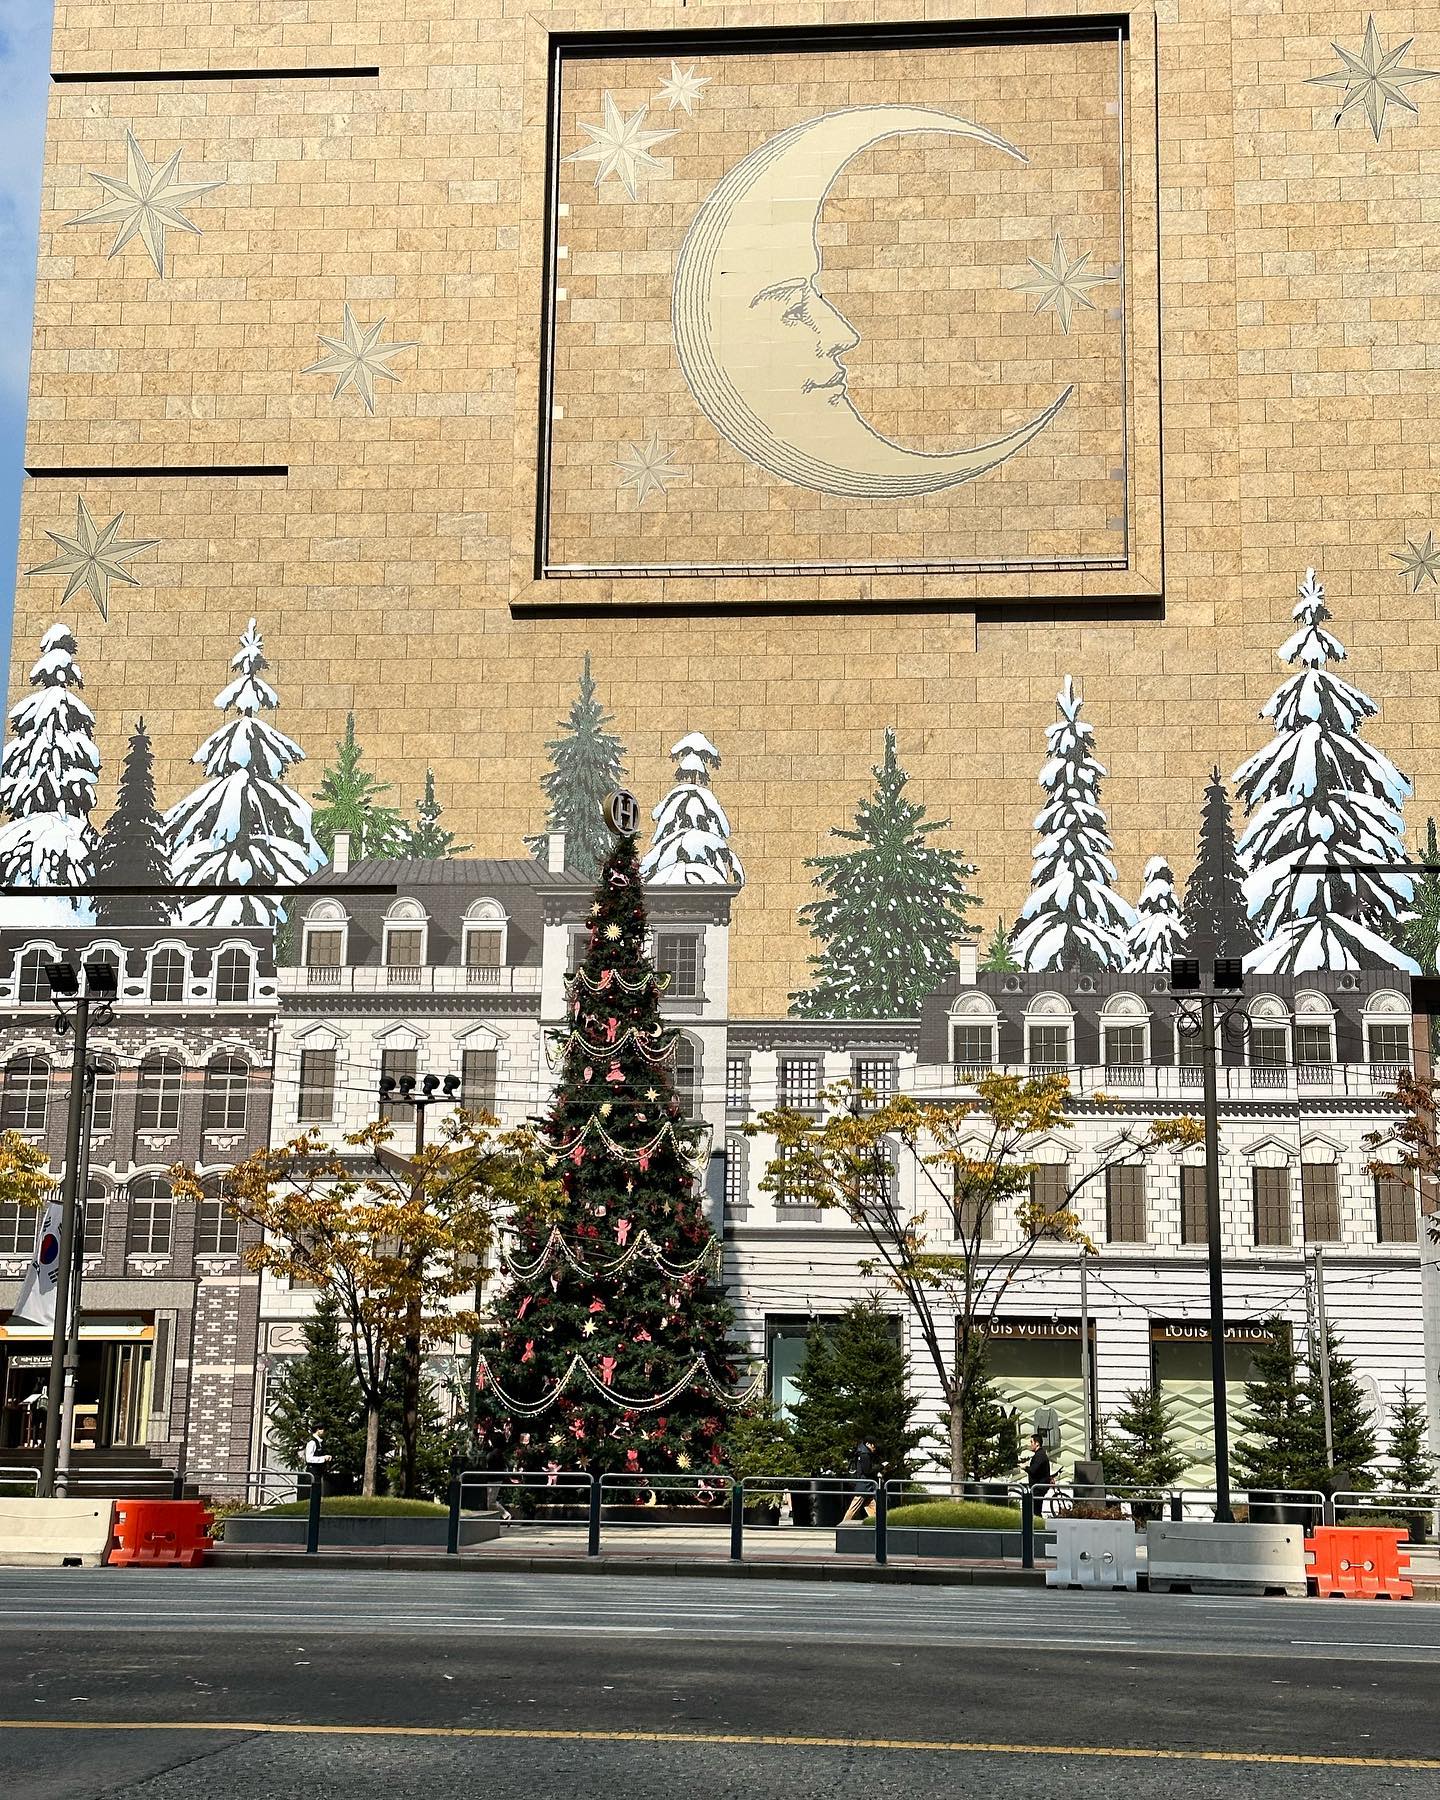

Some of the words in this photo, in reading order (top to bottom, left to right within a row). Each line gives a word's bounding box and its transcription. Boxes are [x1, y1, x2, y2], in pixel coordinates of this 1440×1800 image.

[1018, 1324, 1079, 1336] VUITTON
[1165, 1325, 1209, 1338] LOUIS
[1222, 1326, 1274, 1339] UITTON
